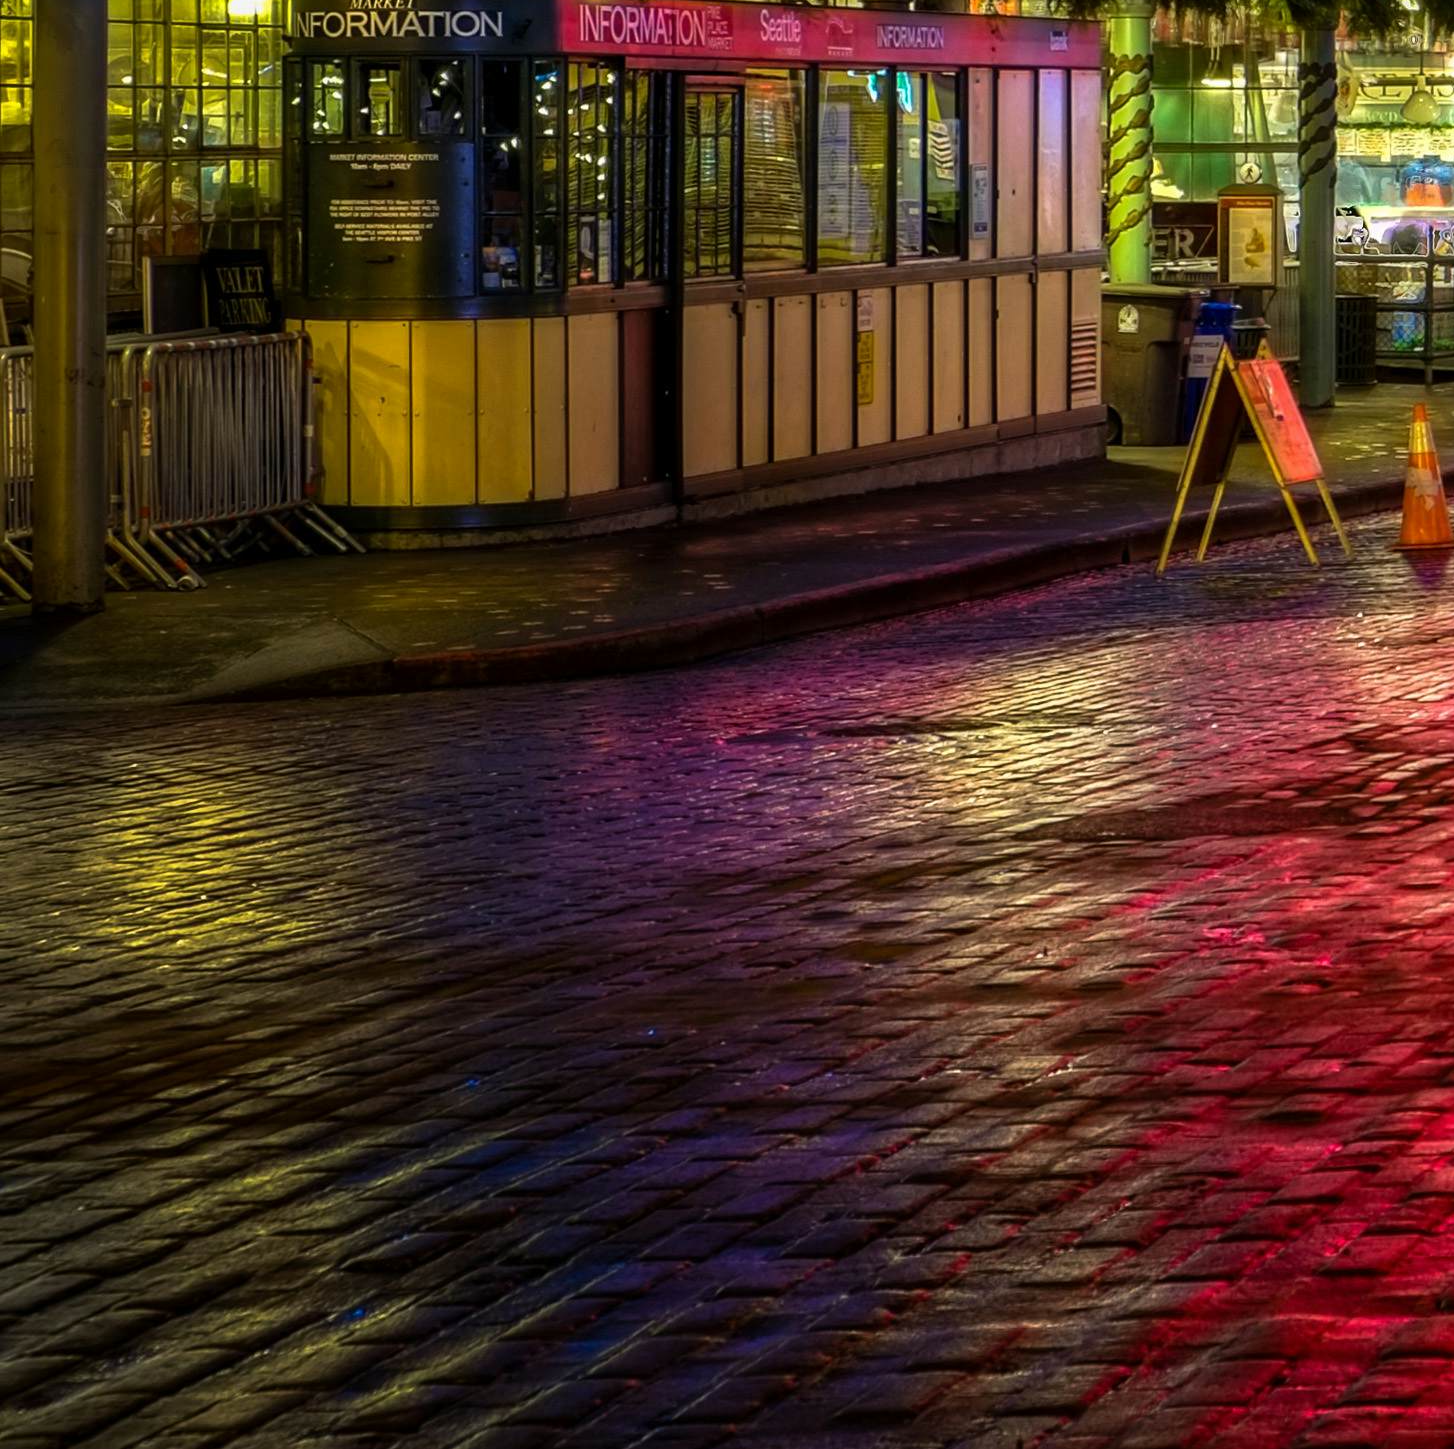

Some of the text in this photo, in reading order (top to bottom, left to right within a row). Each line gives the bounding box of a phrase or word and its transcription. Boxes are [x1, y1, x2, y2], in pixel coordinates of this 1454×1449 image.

[579, 4, 707, 46] INFORMATION
[760, 8, 801, 43] Seattle
[876, 24, 945, 49] INFORMATION
[216, 267, 264, 294] VALET
